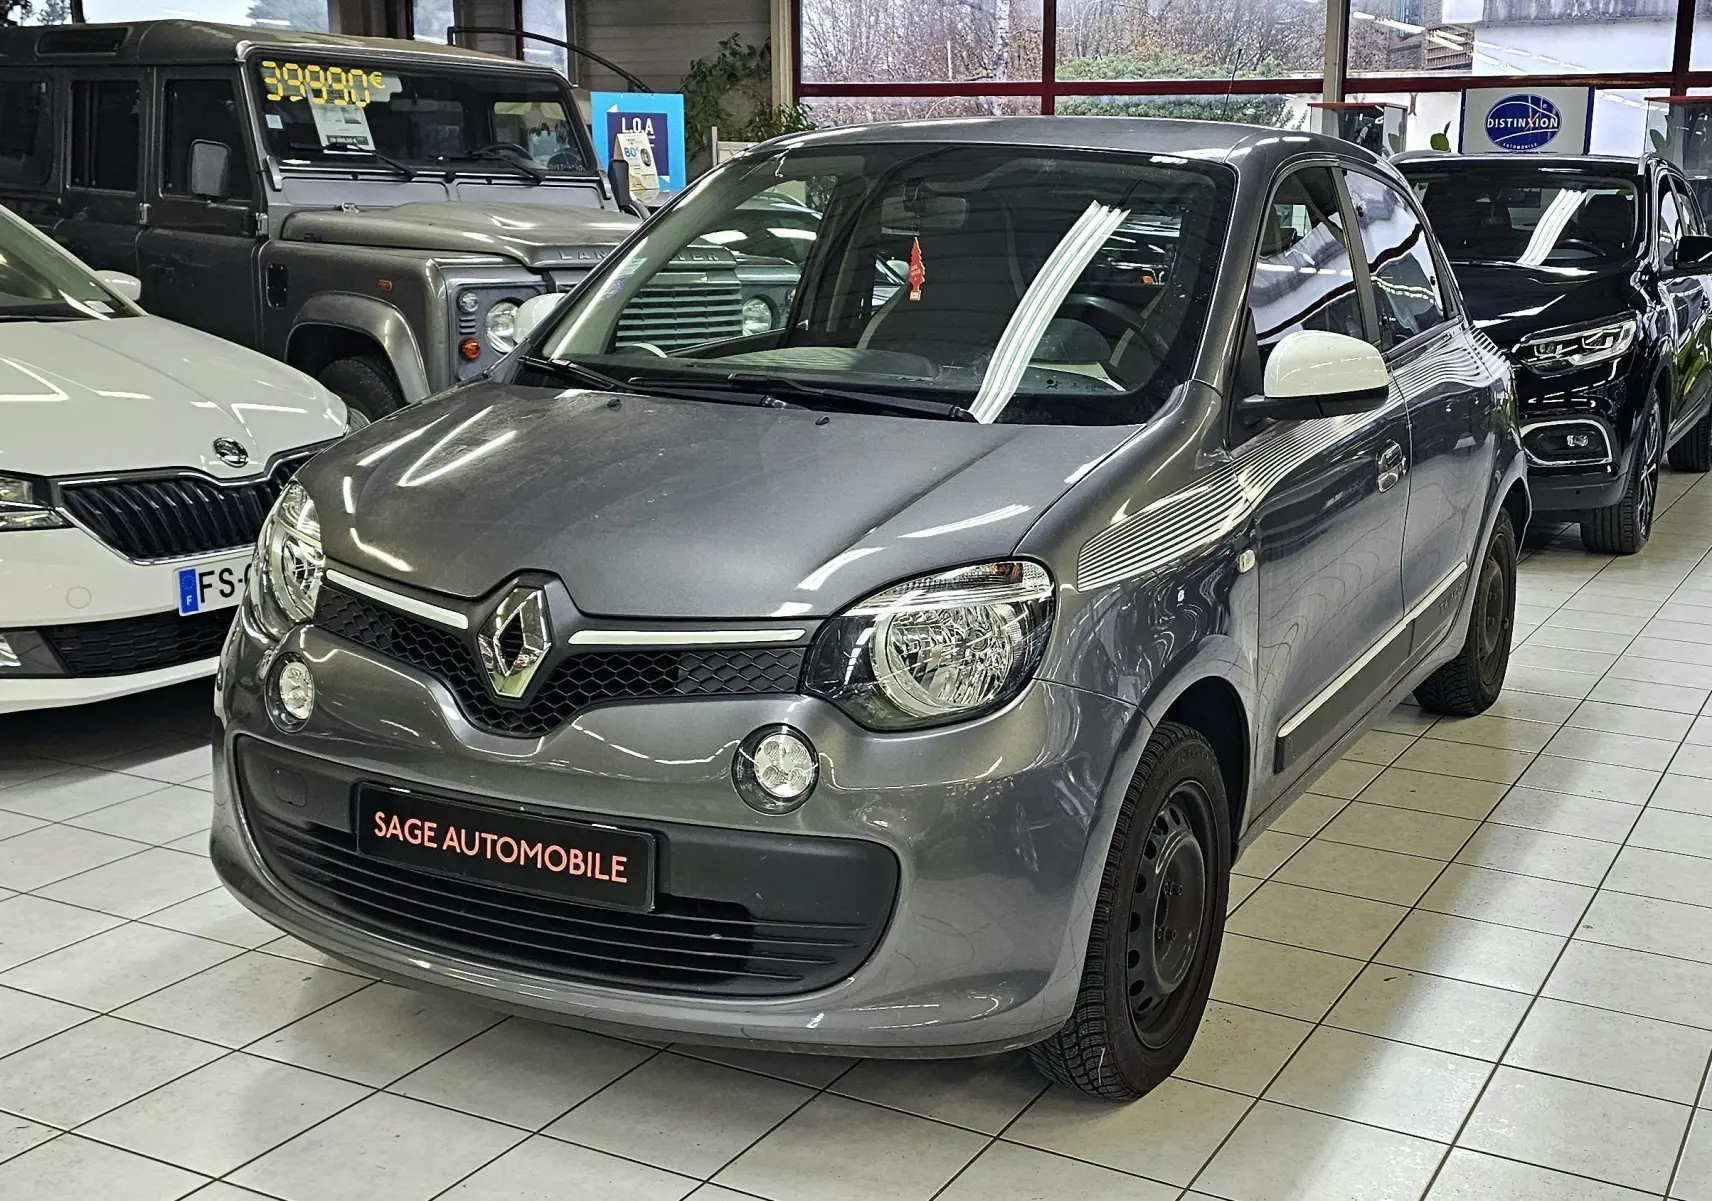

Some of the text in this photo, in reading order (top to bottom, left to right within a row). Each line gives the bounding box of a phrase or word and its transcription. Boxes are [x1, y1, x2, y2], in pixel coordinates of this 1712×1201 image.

[1487, 114, 1559, 129] DISTINXION
[558, 250, 607, 260] LAN
[186, 595, 193, 605] F
[374, 811, 628, 883] SAGE AUTOMOBILE
